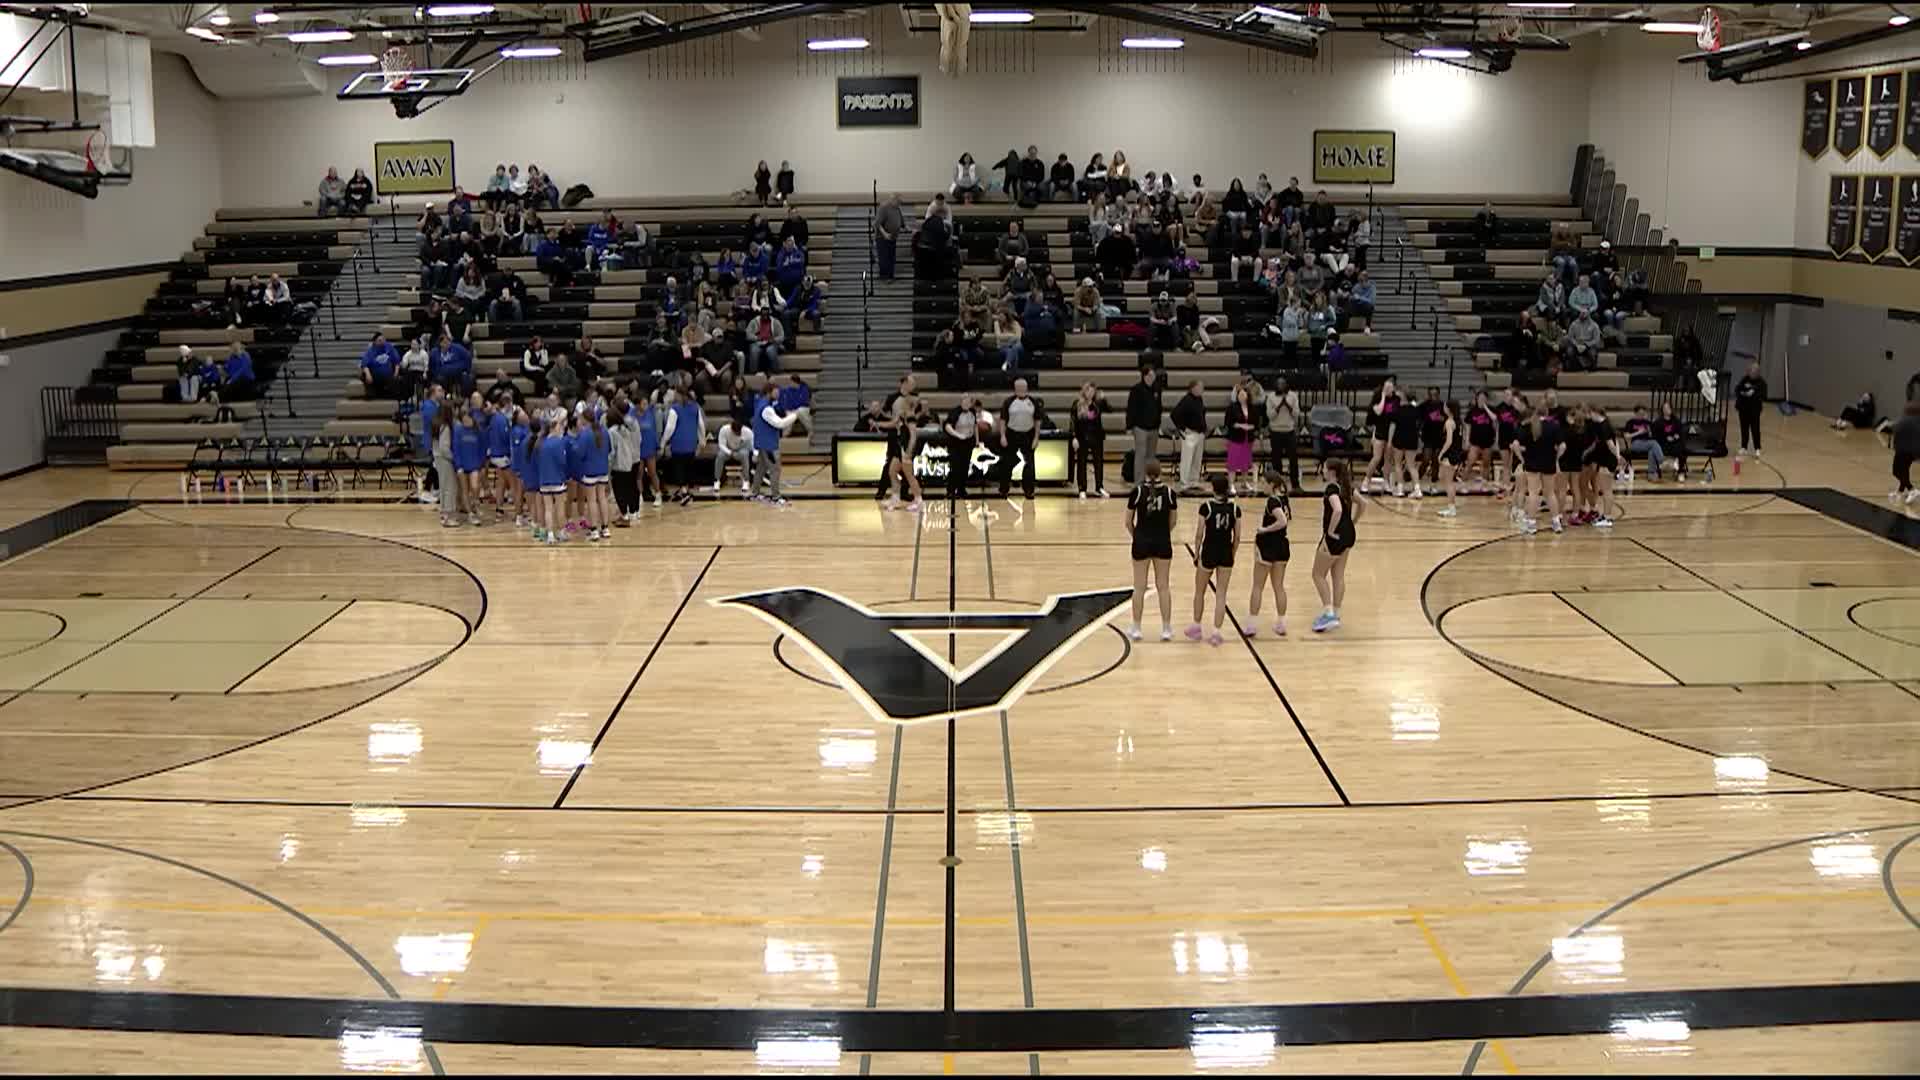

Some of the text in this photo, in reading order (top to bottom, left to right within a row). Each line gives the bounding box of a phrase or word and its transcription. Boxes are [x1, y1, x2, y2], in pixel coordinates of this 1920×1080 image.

[843, 93, 913, 111] PARENTS
[1321, 145, 1388, 168] HOME
[382, 156, 447, 179] AWAY
[1215, 512, 1230, 529] 14
